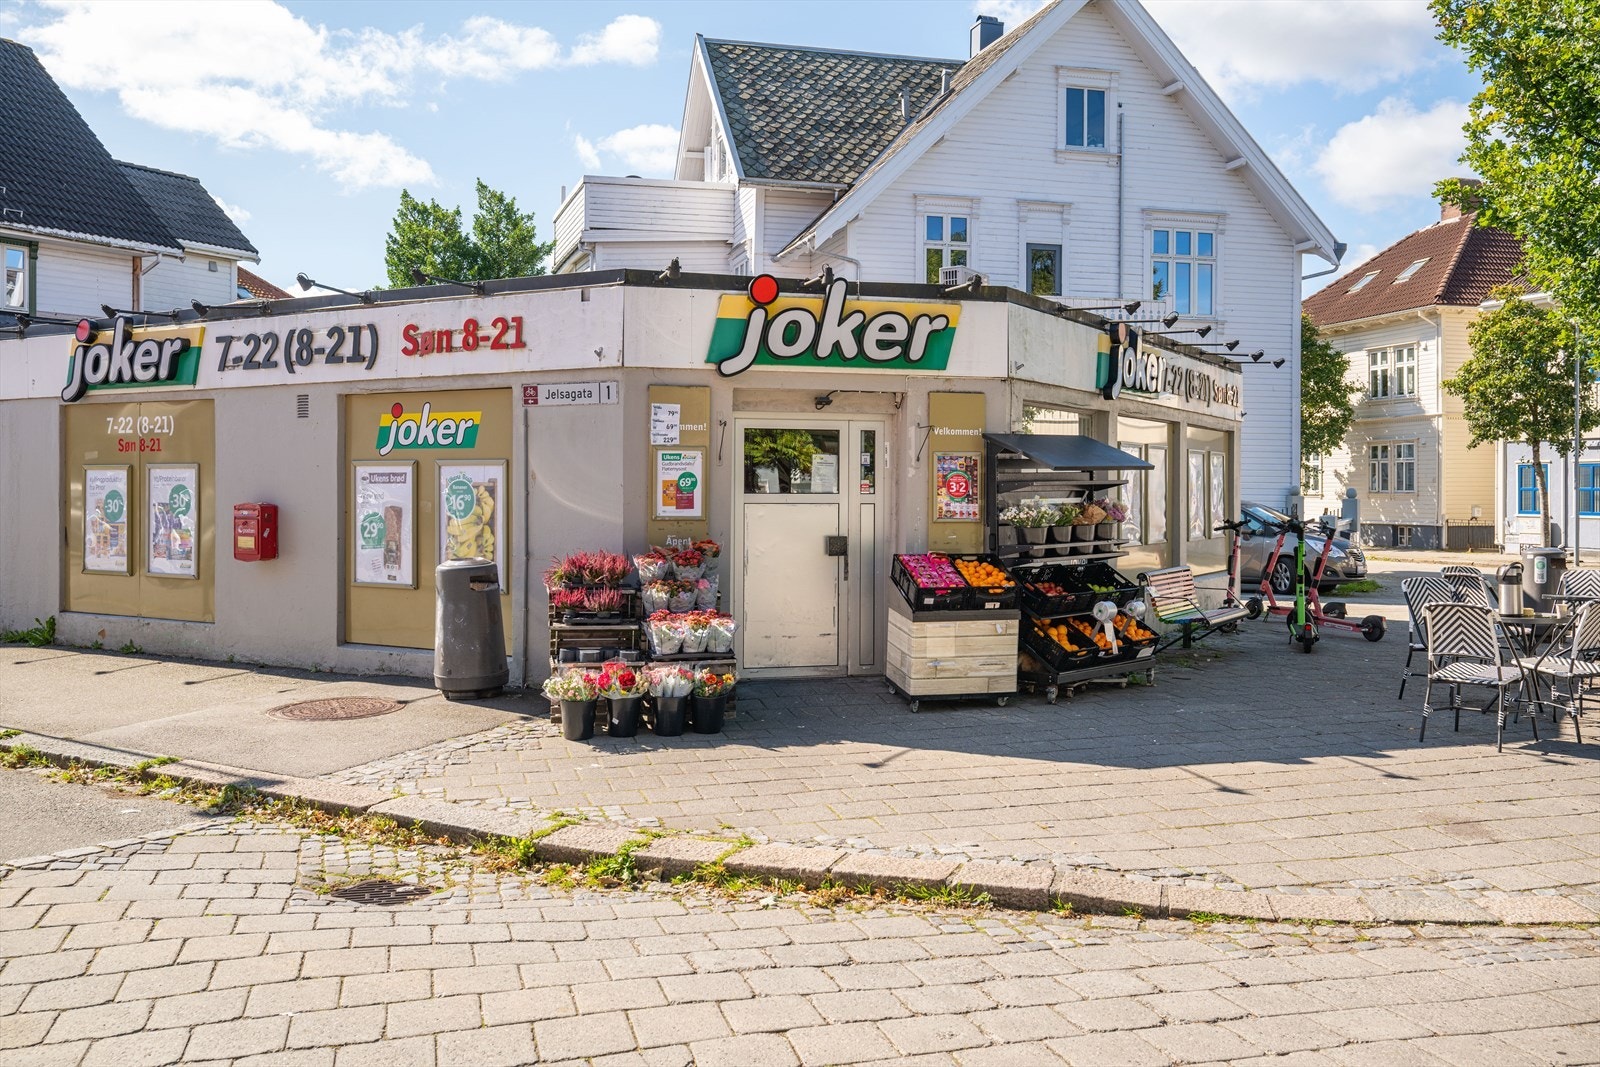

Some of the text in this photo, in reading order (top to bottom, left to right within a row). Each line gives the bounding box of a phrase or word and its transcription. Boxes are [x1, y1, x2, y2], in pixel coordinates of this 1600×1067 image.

[401, 316, 526, 357] Søn 8-21
[717, 274, 950, 377] joker
[61, 316, 191, 402] joker
[215, 323, 378, 374] 7-22 (8-21)
[1103, 323, 1167, 400] joker
[545, 385, 611, 401] Jelsagata 1
[106, 415, 174, 436] 7-22 (8-21)
[118, 438, 162, 452] Søn 8-21
[379, 402, 474, 456] joker
[934, 427, 982, 435] Velkommen!
[391, 474, 406, 482] brød
